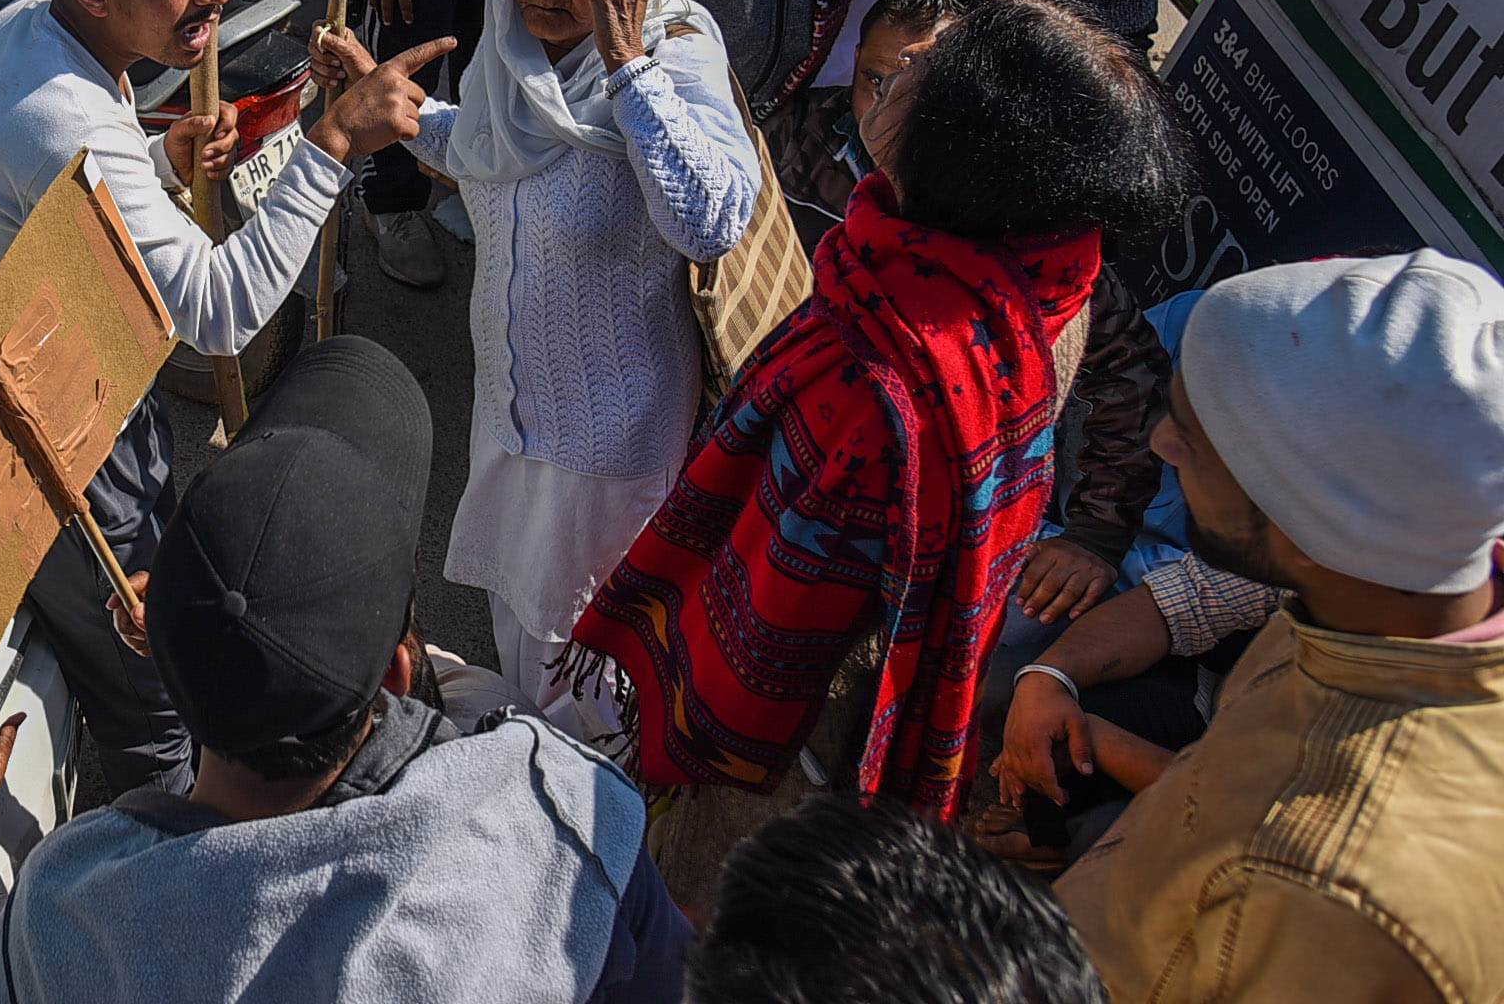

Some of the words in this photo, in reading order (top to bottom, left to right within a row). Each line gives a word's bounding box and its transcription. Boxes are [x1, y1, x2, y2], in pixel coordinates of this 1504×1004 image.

[1174, 81, 1213, 137] BOTH
[1207, 130, 1243, 180] SIDE
[1238, 175, 1281, 234] OPEN
[1213, 19, 1250, 71] 3&4
[1243, 62, 1282, 114] BHK
[1274, 103, 1339, 191] FLOORS
[1236, 113, 1276, 171] WITH
[1268, 160, 1305, 207] LIFT
[246, 153, 273, 184] HR
